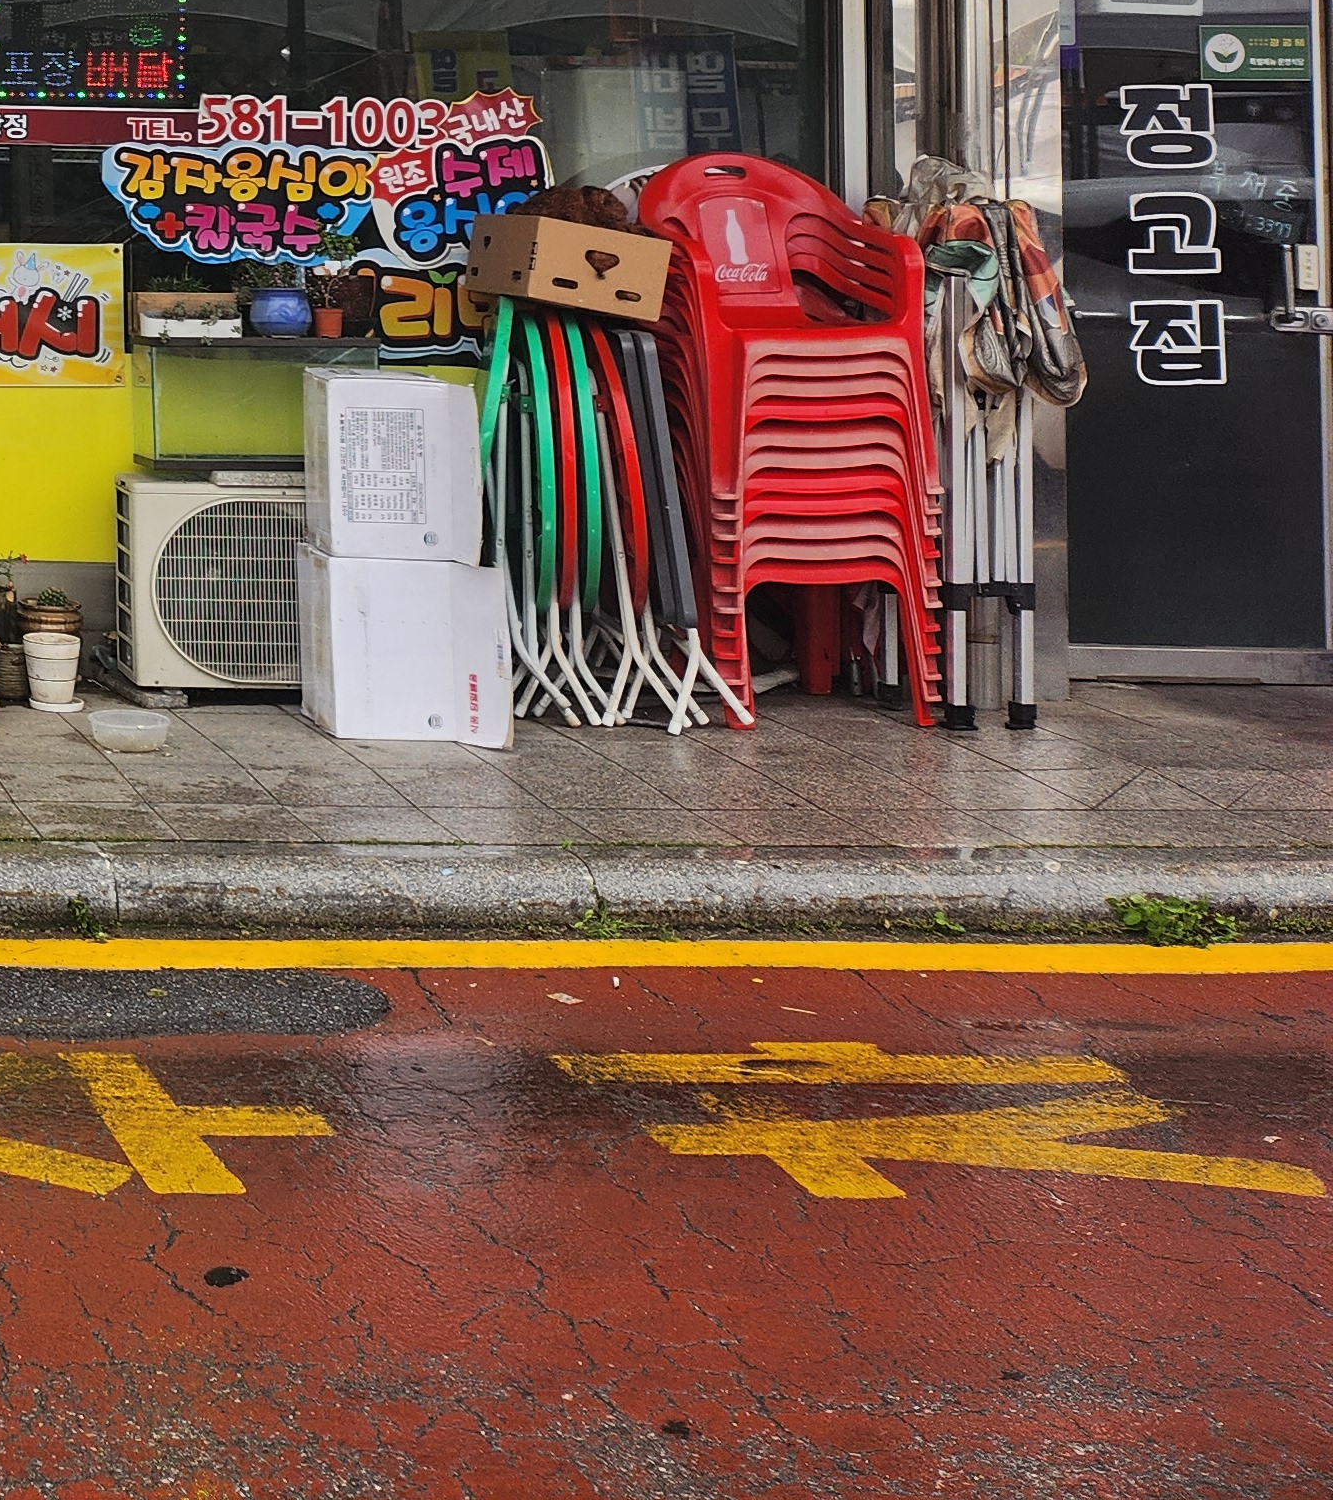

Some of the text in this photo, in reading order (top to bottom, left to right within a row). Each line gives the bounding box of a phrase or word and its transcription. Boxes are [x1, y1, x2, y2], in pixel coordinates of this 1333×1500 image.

[126, 117, 193, 141] TEL.
[196, 94, 448, 148] 581-1003
[449, 98, 526, 142] 국내산
[120, 151, 369, 202] 감자옹심이
[378, 160, 428, 195] 원조
[442, 145, 535, 199] 수제
[1120, 83, 1228, 386] 정고집
